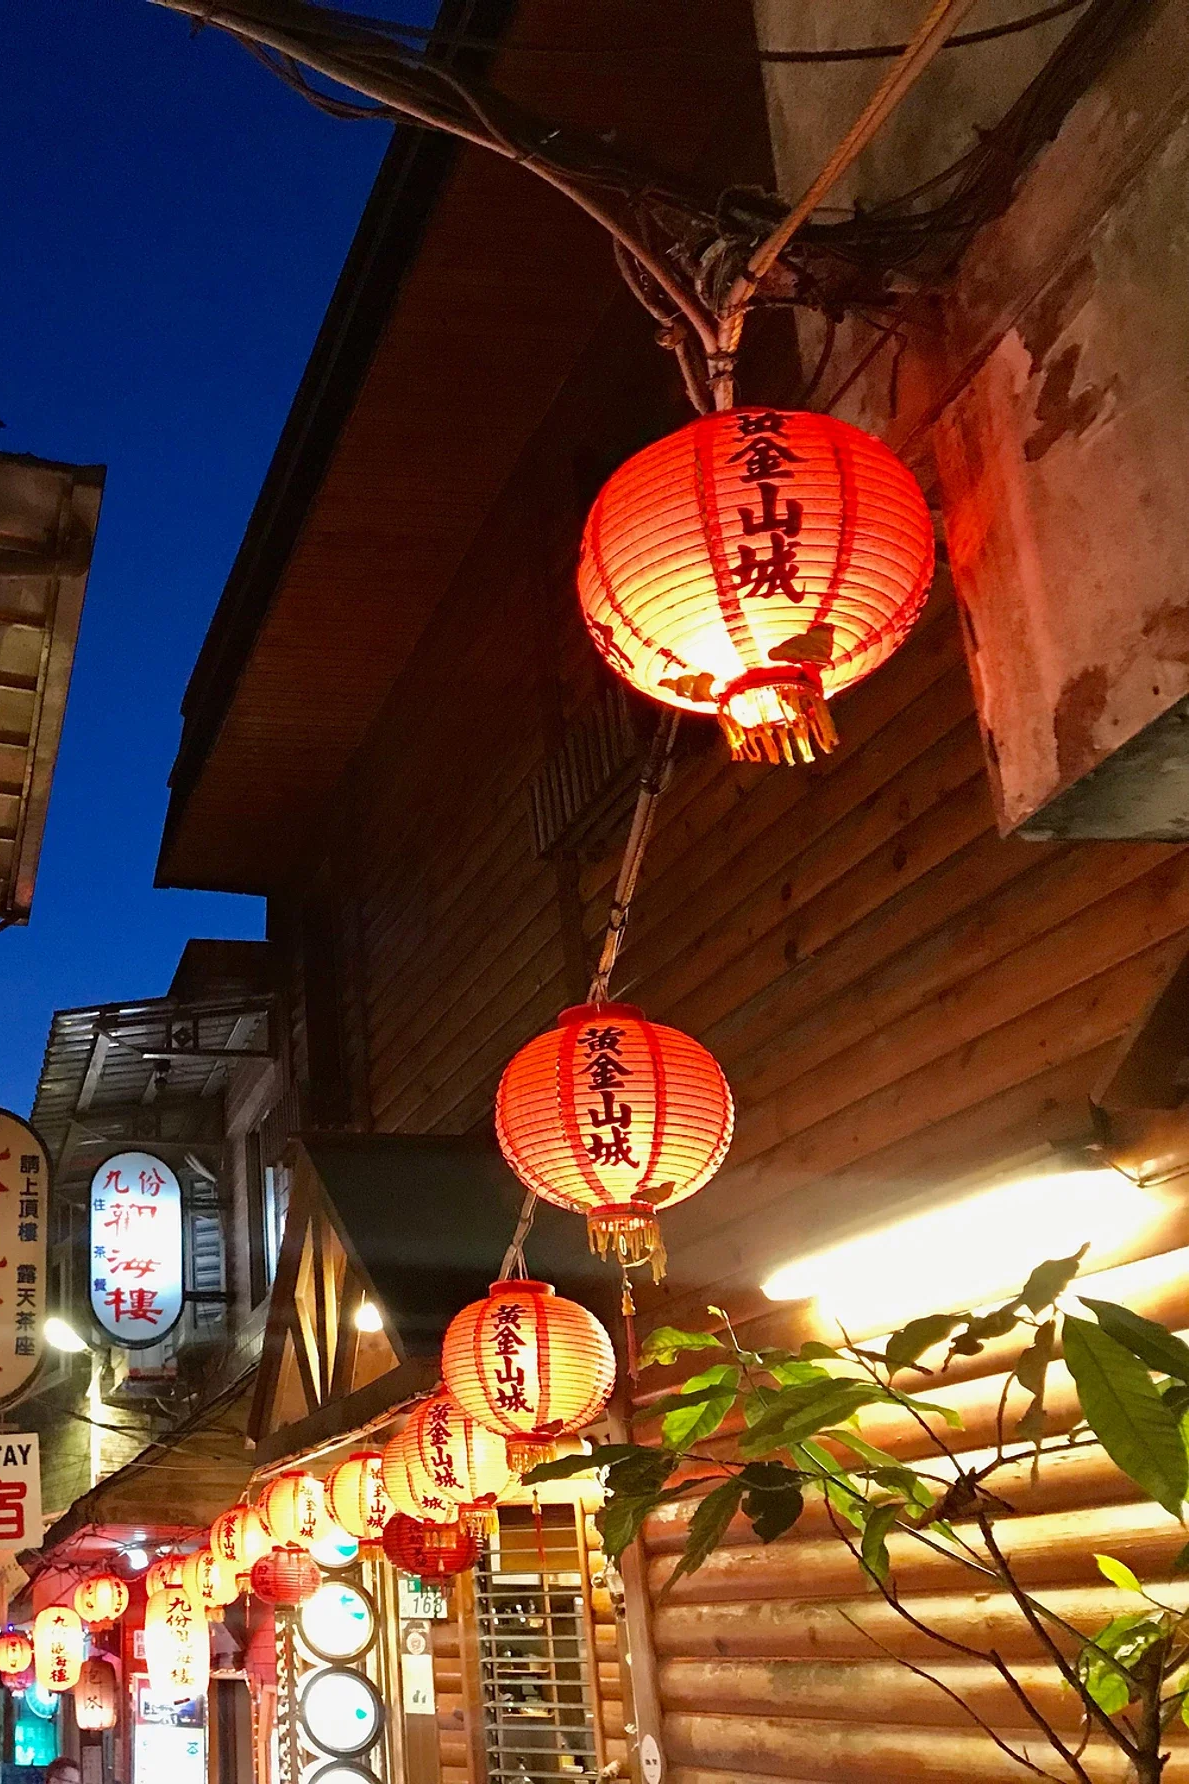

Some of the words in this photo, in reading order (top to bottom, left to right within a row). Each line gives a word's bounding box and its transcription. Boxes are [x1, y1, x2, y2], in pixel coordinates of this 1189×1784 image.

[18, 1154, 41, 1243] 請上頂樓
[14, 1263, 37, 1357] 露天茶座
